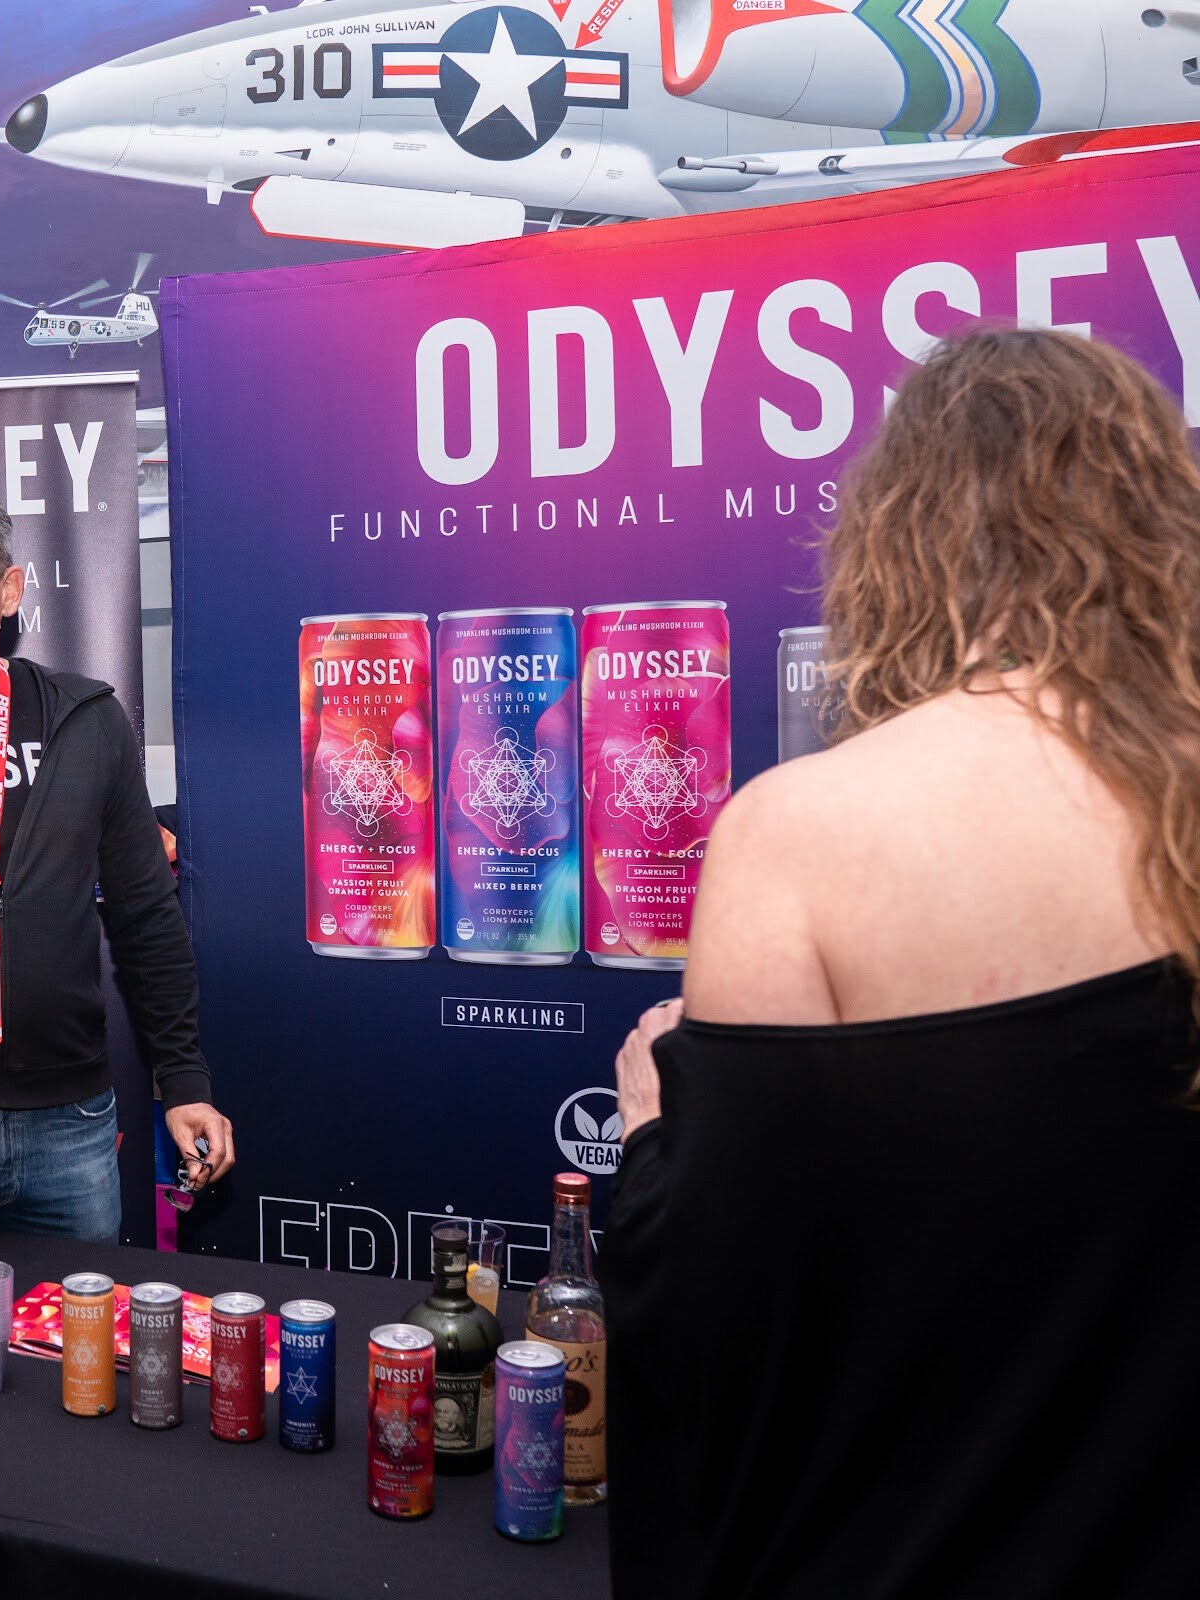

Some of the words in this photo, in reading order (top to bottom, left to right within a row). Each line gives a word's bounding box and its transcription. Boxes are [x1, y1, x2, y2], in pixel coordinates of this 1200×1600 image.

[735, 0, 783, 9] DANGER
[588, 0, 624, 34] RESC
[306, 28, 334, 40] LCDR
[339, 24, 370, 36] JOHN
[375, 20, 435, 32] SULLIVAN
[245, 42, 351, 104] 310
[136, 301, 150, 311] HU
[329, 492, 675, 543] FUNCTIONAL
[602, 624, 638, 633] SPARKLING
[640, 622, 680, 630] MUSHROOM
[317, 634, 349, 642] SPARKLING
[351, 632, 388, 640] MUSHROOM
[390, 632, 408, 640] ELIXIR
[456, 629, 490, 638] SPARKLING
[452, 654, 559, 684] ODYSSEY
[598, 650, 710, 681] ODYSSEY
[314, 658, 414, 686] ODYSSEY
[462, 692, 547, 703] MUSHROOM
[608, 688, 698, 700] MUSHROOM
[322, 695, 403, 705] MUSHROOM
[338, 707, 387, 716] ELIXIR
[478, 704, 530, 714] ELIXIR
[624, 702, 680, 712] ELIXIR
[320, 844, 363, 853] ENERGY
[379, 846, 416, 854] FOCUS
[457, 846, 504, 856] ENERGY
[520, 848, 560, 856] FOCUS
[602, 848, 651, 858] ENERGY
[668, 850, 704, 858] FOCU
[377, 880, 405, 888] FRUIT
[474, 882, 506, 890] MIXED
[328, 888, 367, 896] ORANGE
[378, 889, 409, 897] GUAVA
[615, 885, 661, 893] DRAGON
[666, 886, 697, 894] FRUIT
[625, 895, 687, 904] LEMONADE
[345, 904, 392, 912] CORDYCEPS
[483, 908, 533, 916] CORDYCEPS
[629, 912, 682, 920] CORDYCEPS
[457, 1004, 566, 1027] SPARKLING
[575, 1145, 624, 1167] VEGAN
[64, 1302, 105, 1320] ODYSSEY
[131, 1311, 175, 1328] ODYSSEY
[211, 1320, 246, 1338] DYSSEY
[281, 1329, 325, 1348] ODYSSEY
[374, 1364, 424, 1384] ODYSSEY
[509, 1384, 564, 1404] ODYSSEY
[287, 1419, 316, 1428] IMMUNITY
